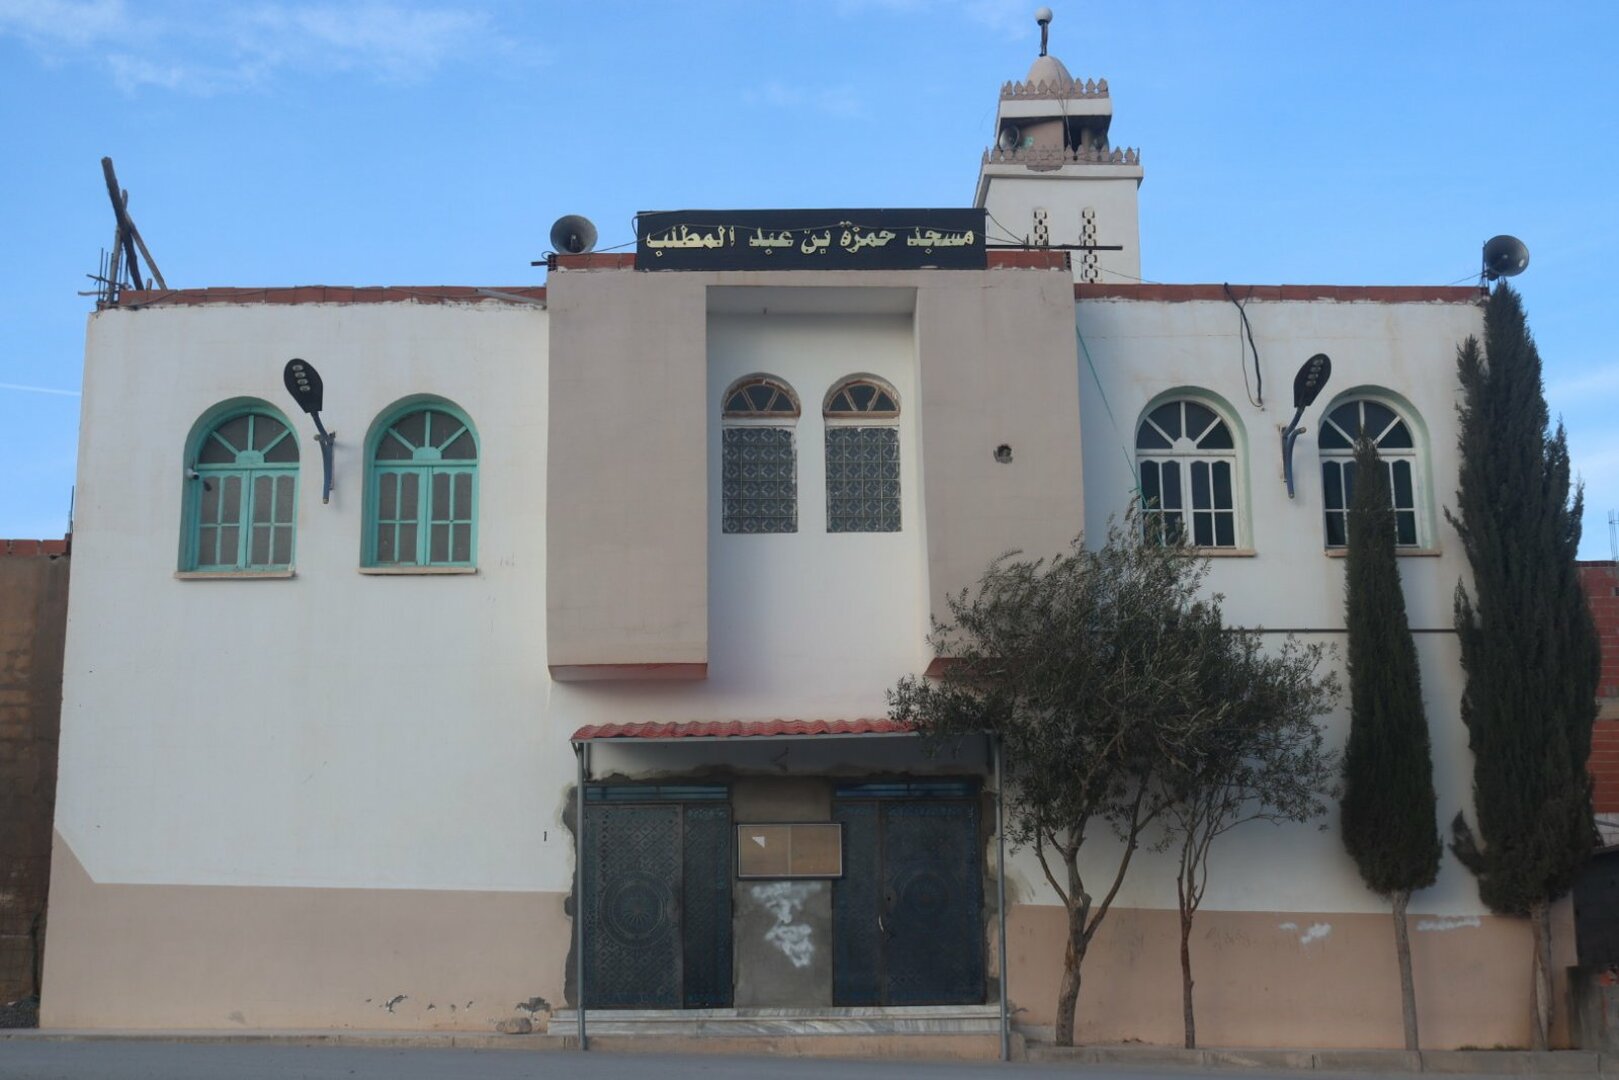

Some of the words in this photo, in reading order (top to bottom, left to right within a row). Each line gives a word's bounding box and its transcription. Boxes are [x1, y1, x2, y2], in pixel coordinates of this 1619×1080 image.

[646, 224, 736, 257] المطلب
[748, 226, 794, 255] عبد
[801, 228, 831, 254] بن
[840, 220, 897, 253] حمزة
[907, 226, 975, 255] مسجد
